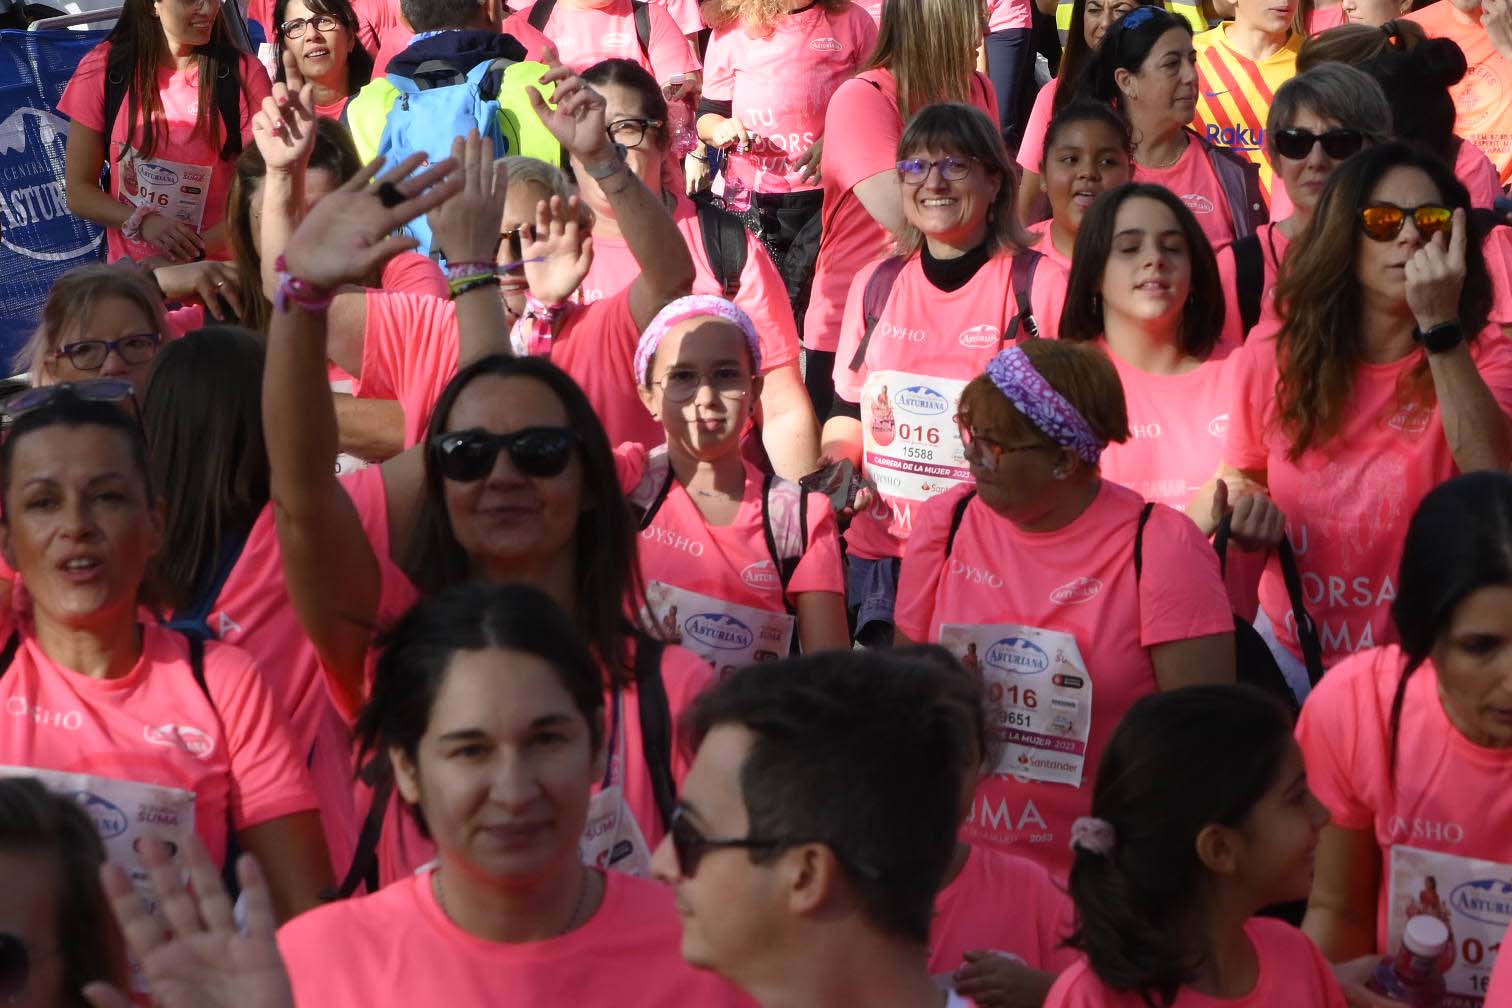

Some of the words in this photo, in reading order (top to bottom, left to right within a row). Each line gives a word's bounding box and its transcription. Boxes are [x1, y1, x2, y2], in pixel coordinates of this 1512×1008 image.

[746, 109, 774, 126] TU
[1207, 123, 1264, 145] Raku
[140, 186, 169, 206] 016
[899, 395, 944, 411] ASTURIANA
[899, 423, 940, 444] 016
[903, 447, 933, 460] 15588
[875, 456, 901, 469] CARRERA
[902, 463, 913, 471] DE
[914, 464, 923, 472] LA
[924, 465, 951, 476] MUJER
[953, 468, 970, 478] 2023
[642, 526, 704, 557] OYSHO
[690, 620, 748, 645] ASTURIANA
[990, 649, 1043, 669] ASTURIANA
[1009, 733, 1019, 741] LA
[1021, 735, 1051, 746] MUJER
[1055, 740, 1076, 750] 2023
[1029, 757, 1077, 772] Santander
[136, 813, 178, 827] SUMA
